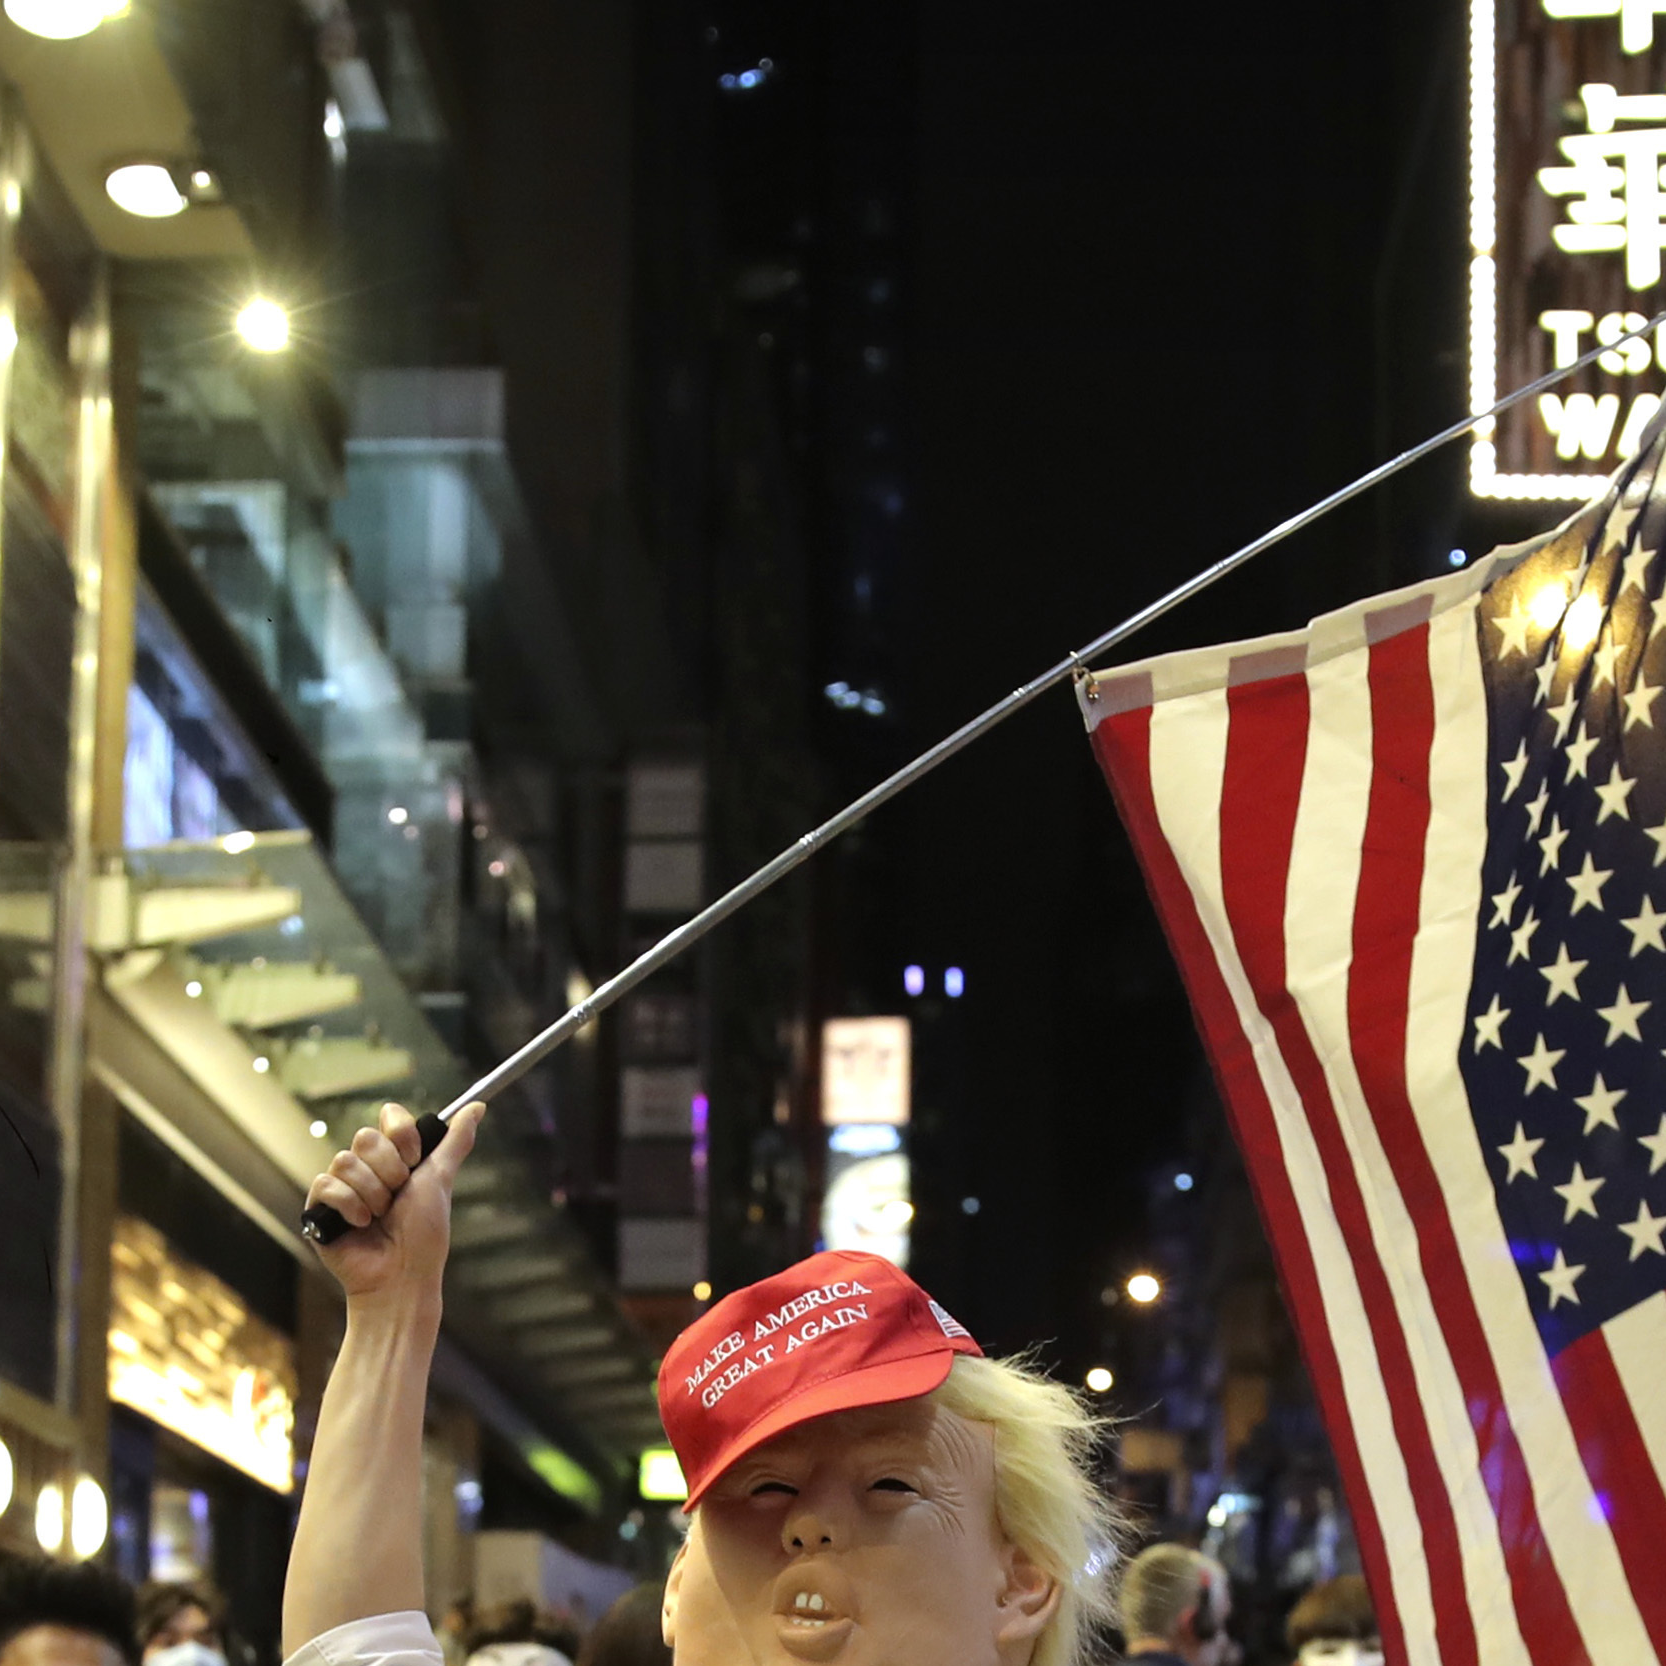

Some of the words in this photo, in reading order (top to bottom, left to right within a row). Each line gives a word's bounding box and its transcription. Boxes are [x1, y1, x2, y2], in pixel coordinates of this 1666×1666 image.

[685, 1330, 745, 1396] MAKE
[753, 1280, 873, 1342] AMERICA
[701, 1344, 775, 1409] GREAT
[784, 1303, 869, 1354] AGAIN
